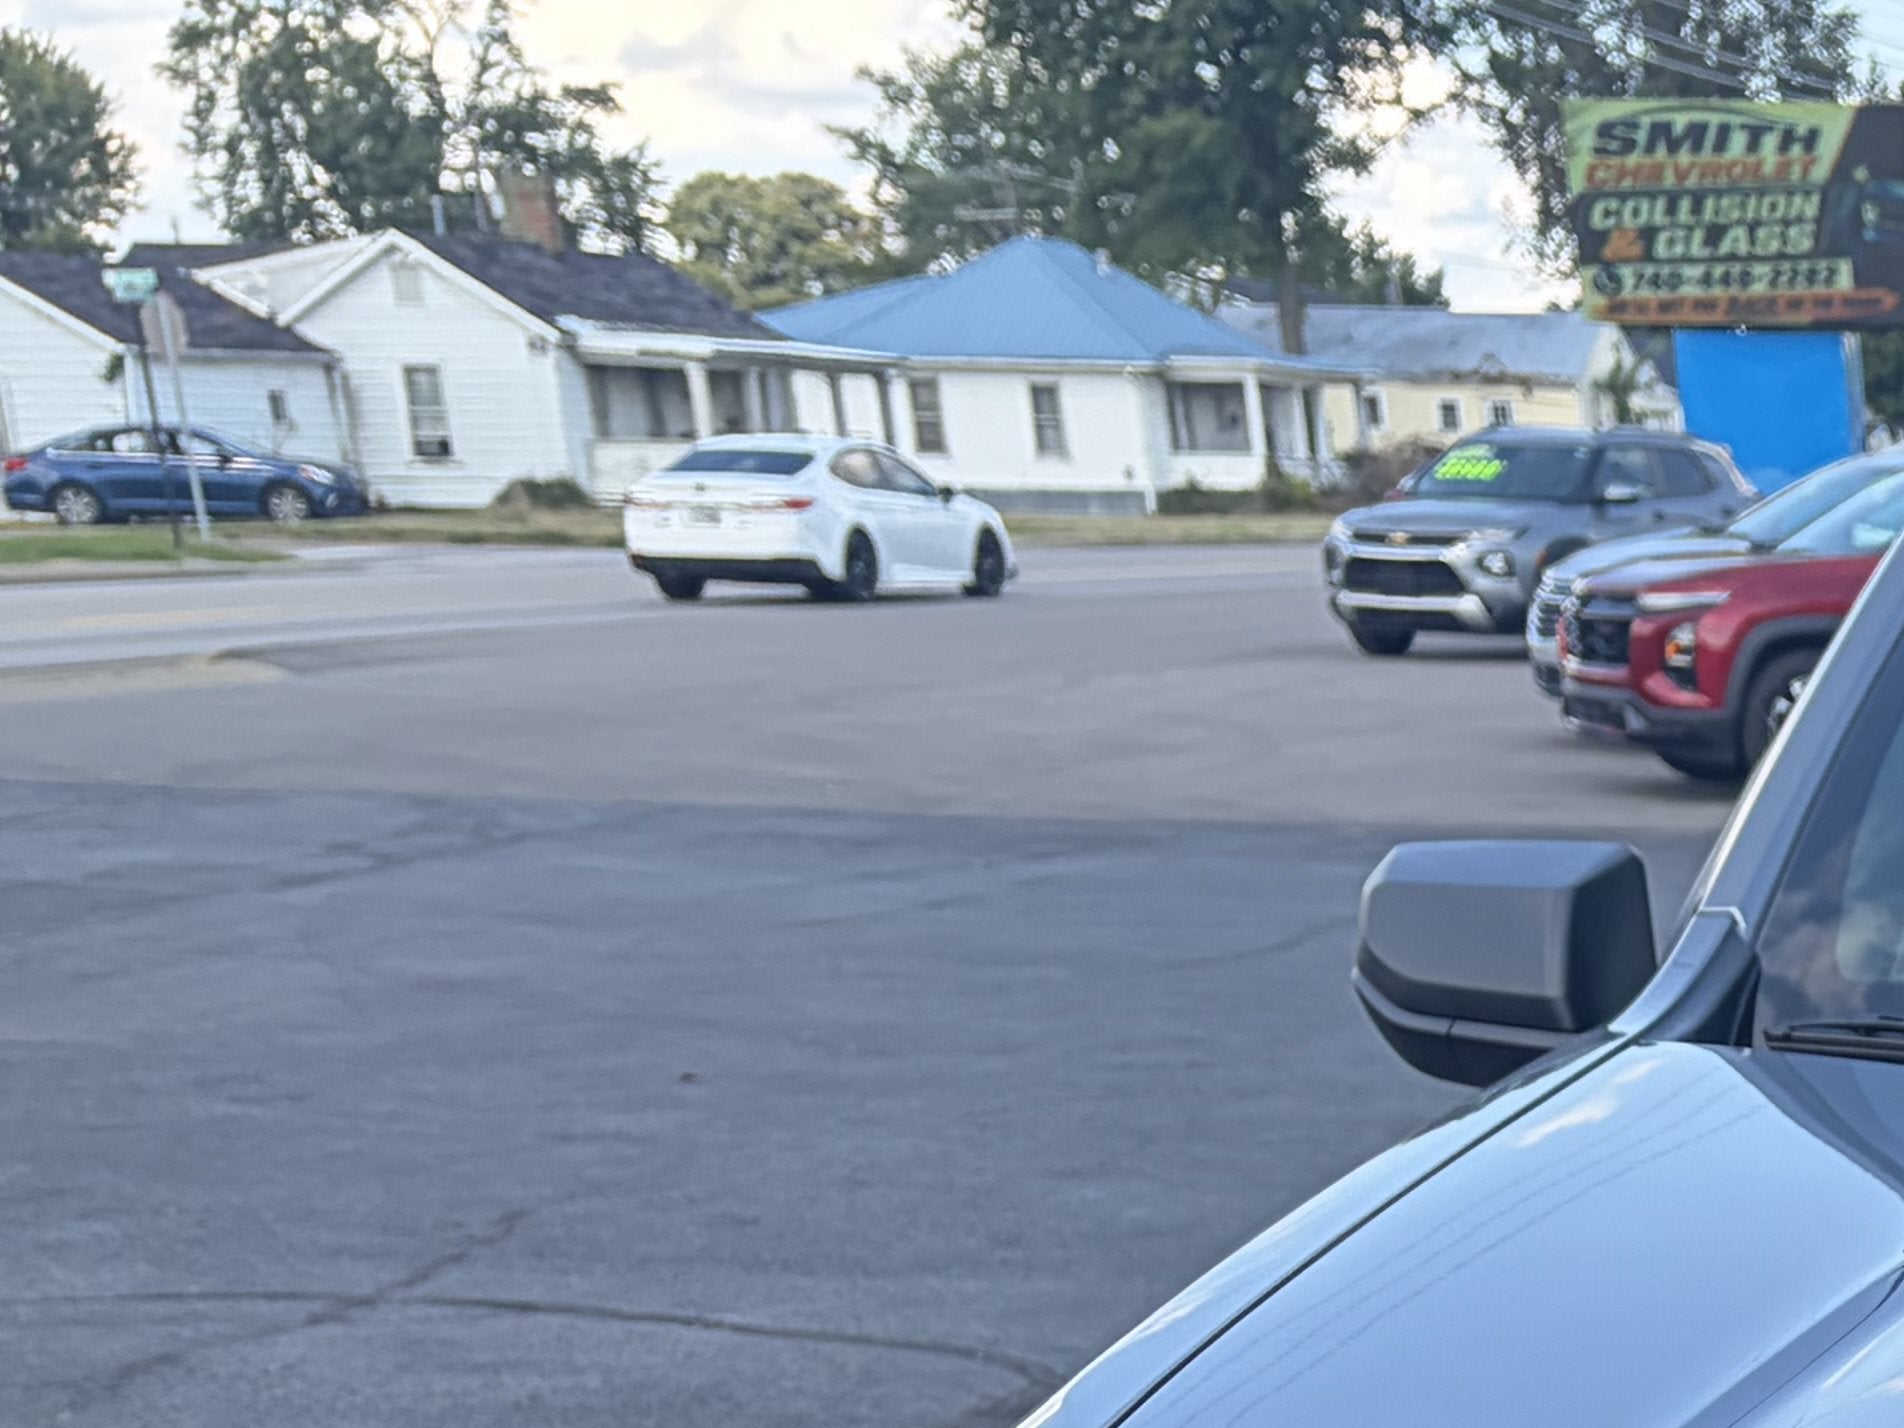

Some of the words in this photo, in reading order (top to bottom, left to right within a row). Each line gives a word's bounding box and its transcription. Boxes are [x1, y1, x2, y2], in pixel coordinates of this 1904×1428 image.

[1593, 121, 1821, 156] SMITH
[1586, 156, 1817, 188] CHEVROLET
[1589, 192, 1822, 230] COLLISION
[1603, 227, 1646, 262] &
[1652, 222, 1818, 260] GLASS
